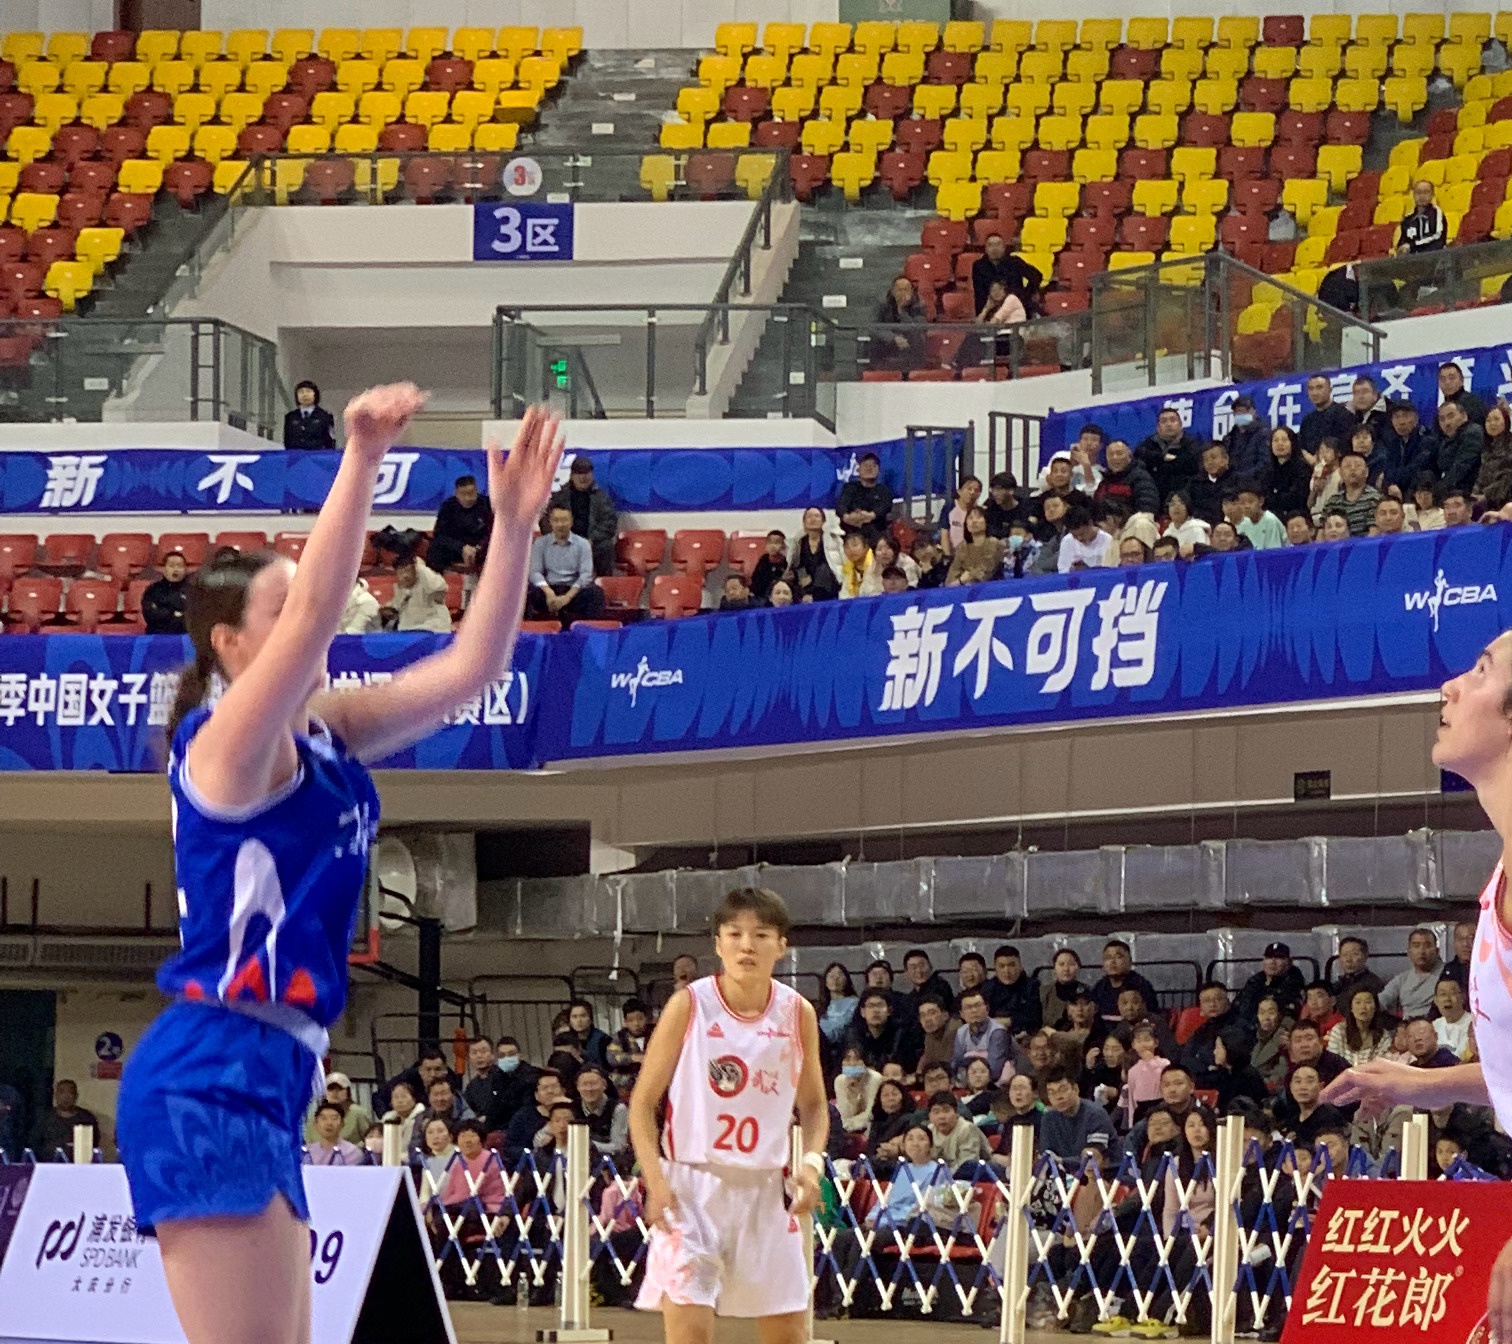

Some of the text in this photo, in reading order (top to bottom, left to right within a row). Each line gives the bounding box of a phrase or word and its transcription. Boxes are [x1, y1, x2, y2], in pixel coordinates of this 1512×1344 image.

[491, 207, 560, 253] 3区
[38, 453, 576, 508] 新不可
[878, 579, 1168, 711] 新不可挡
[0, 672, 182, 726] 季中国女子篮
[713, 1113, 759, 1153] 20
[310, 1230, 344, 1284] 9
[1321, 1207, 1470, 1257] 红红火火
[1302, 1264, 1454, 1331] 红花郎
